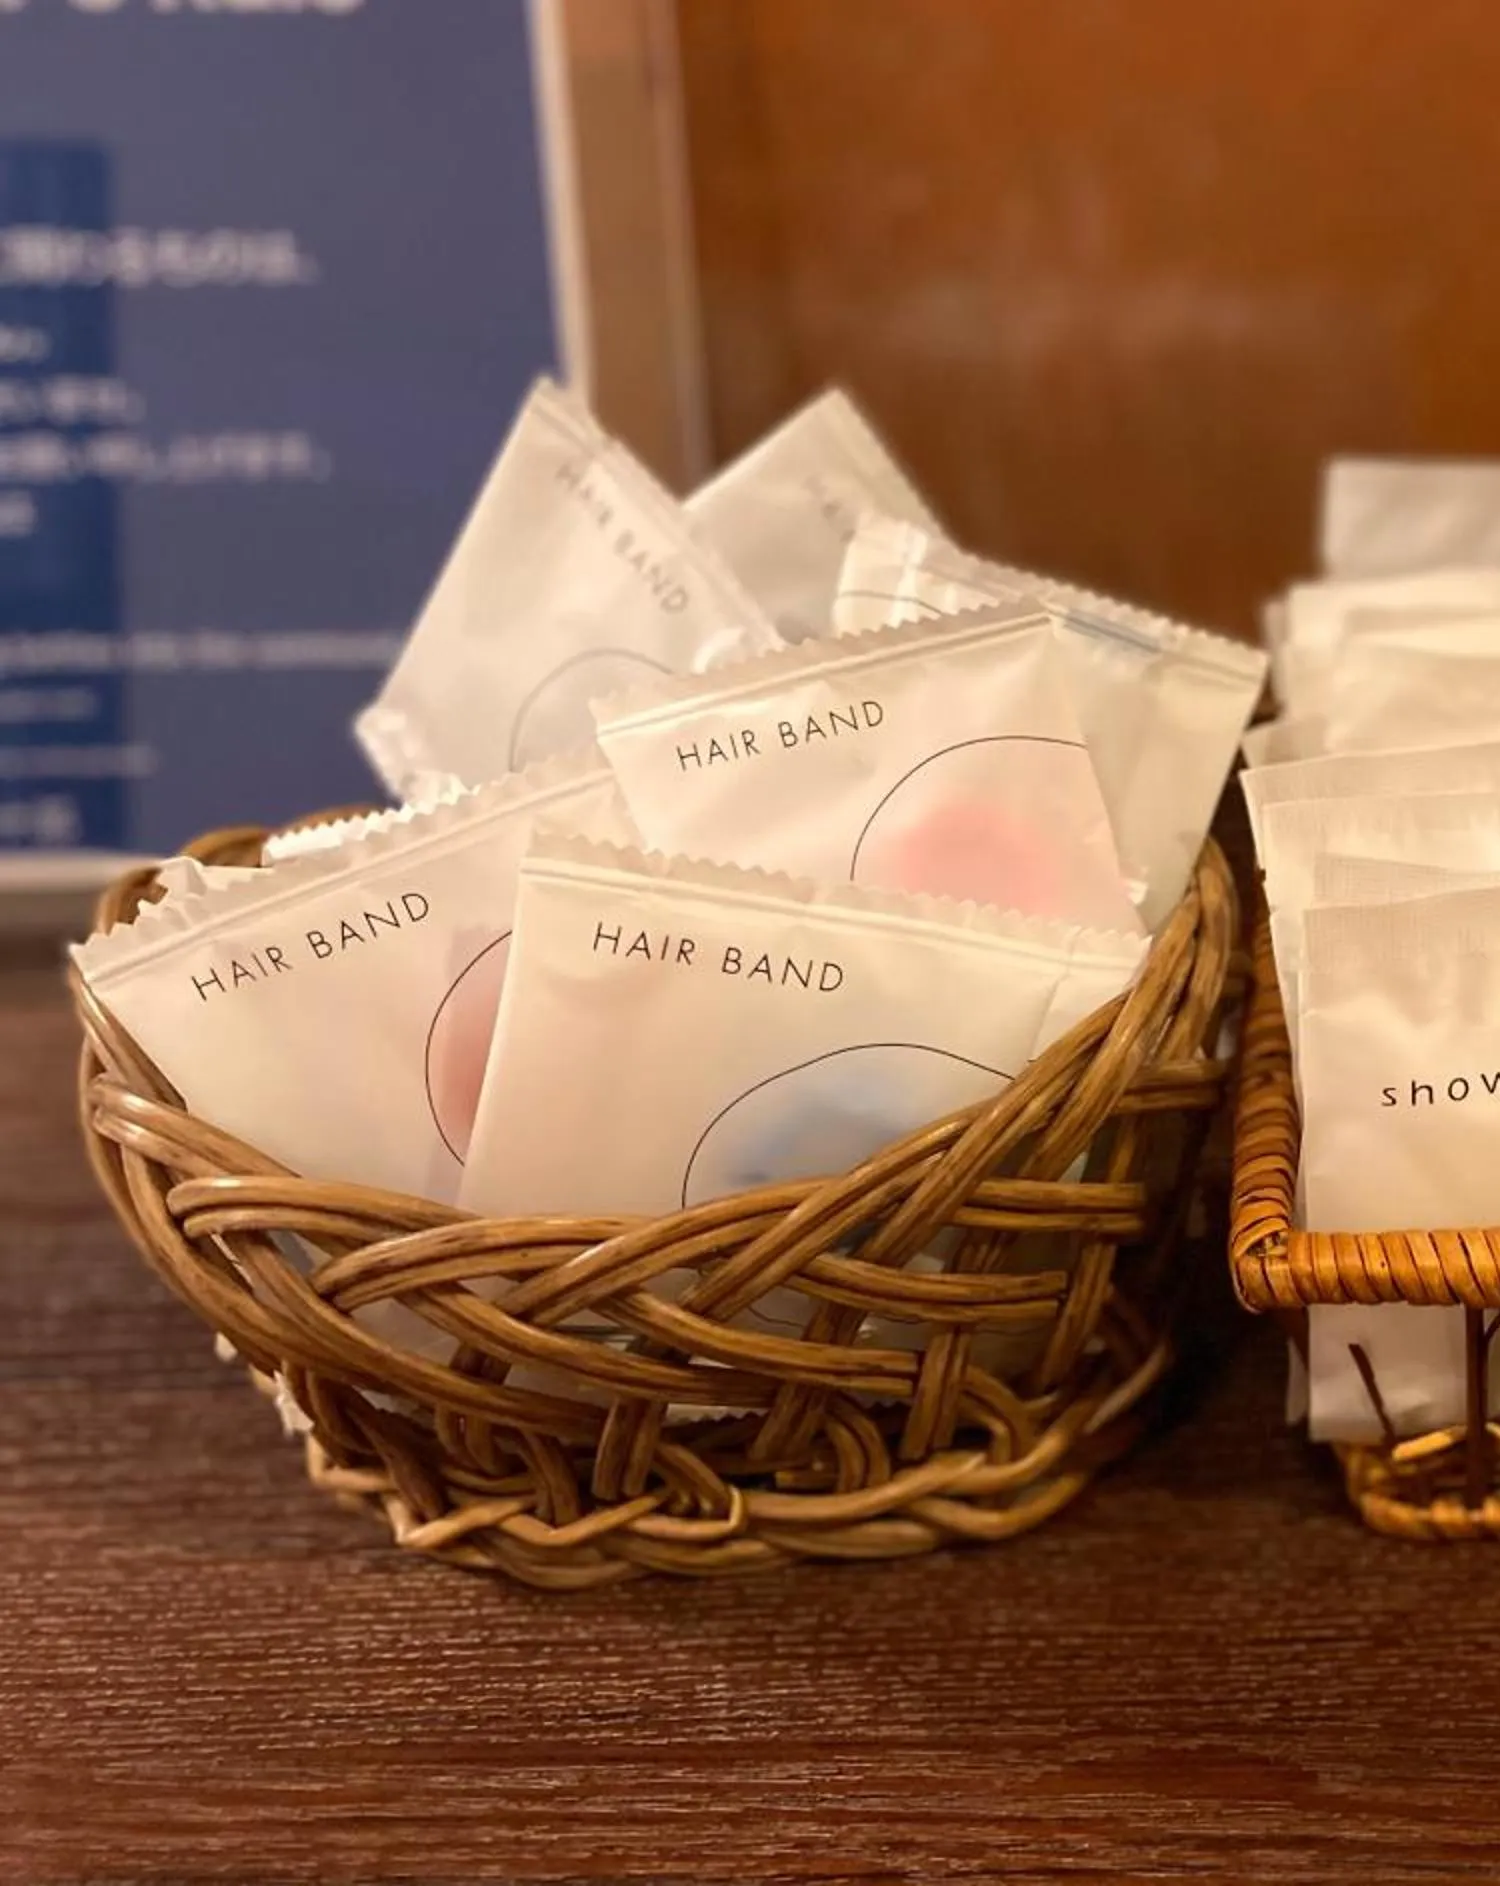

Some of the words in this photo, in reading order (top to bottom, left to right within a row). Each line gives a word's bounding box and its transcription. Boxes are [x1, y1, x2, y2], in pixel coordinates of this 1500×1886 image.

[613, 529, 689, 614] BAND
[676, 729, 760, 772] HAIR
[777, 700, 884, 750] BAND
[191, 946, 292, 1002] HAIR
[305, 892, 430, 960] BAND
[592, 921, 695, 966] HAIR
[721, 946, 844, 993] BAND
